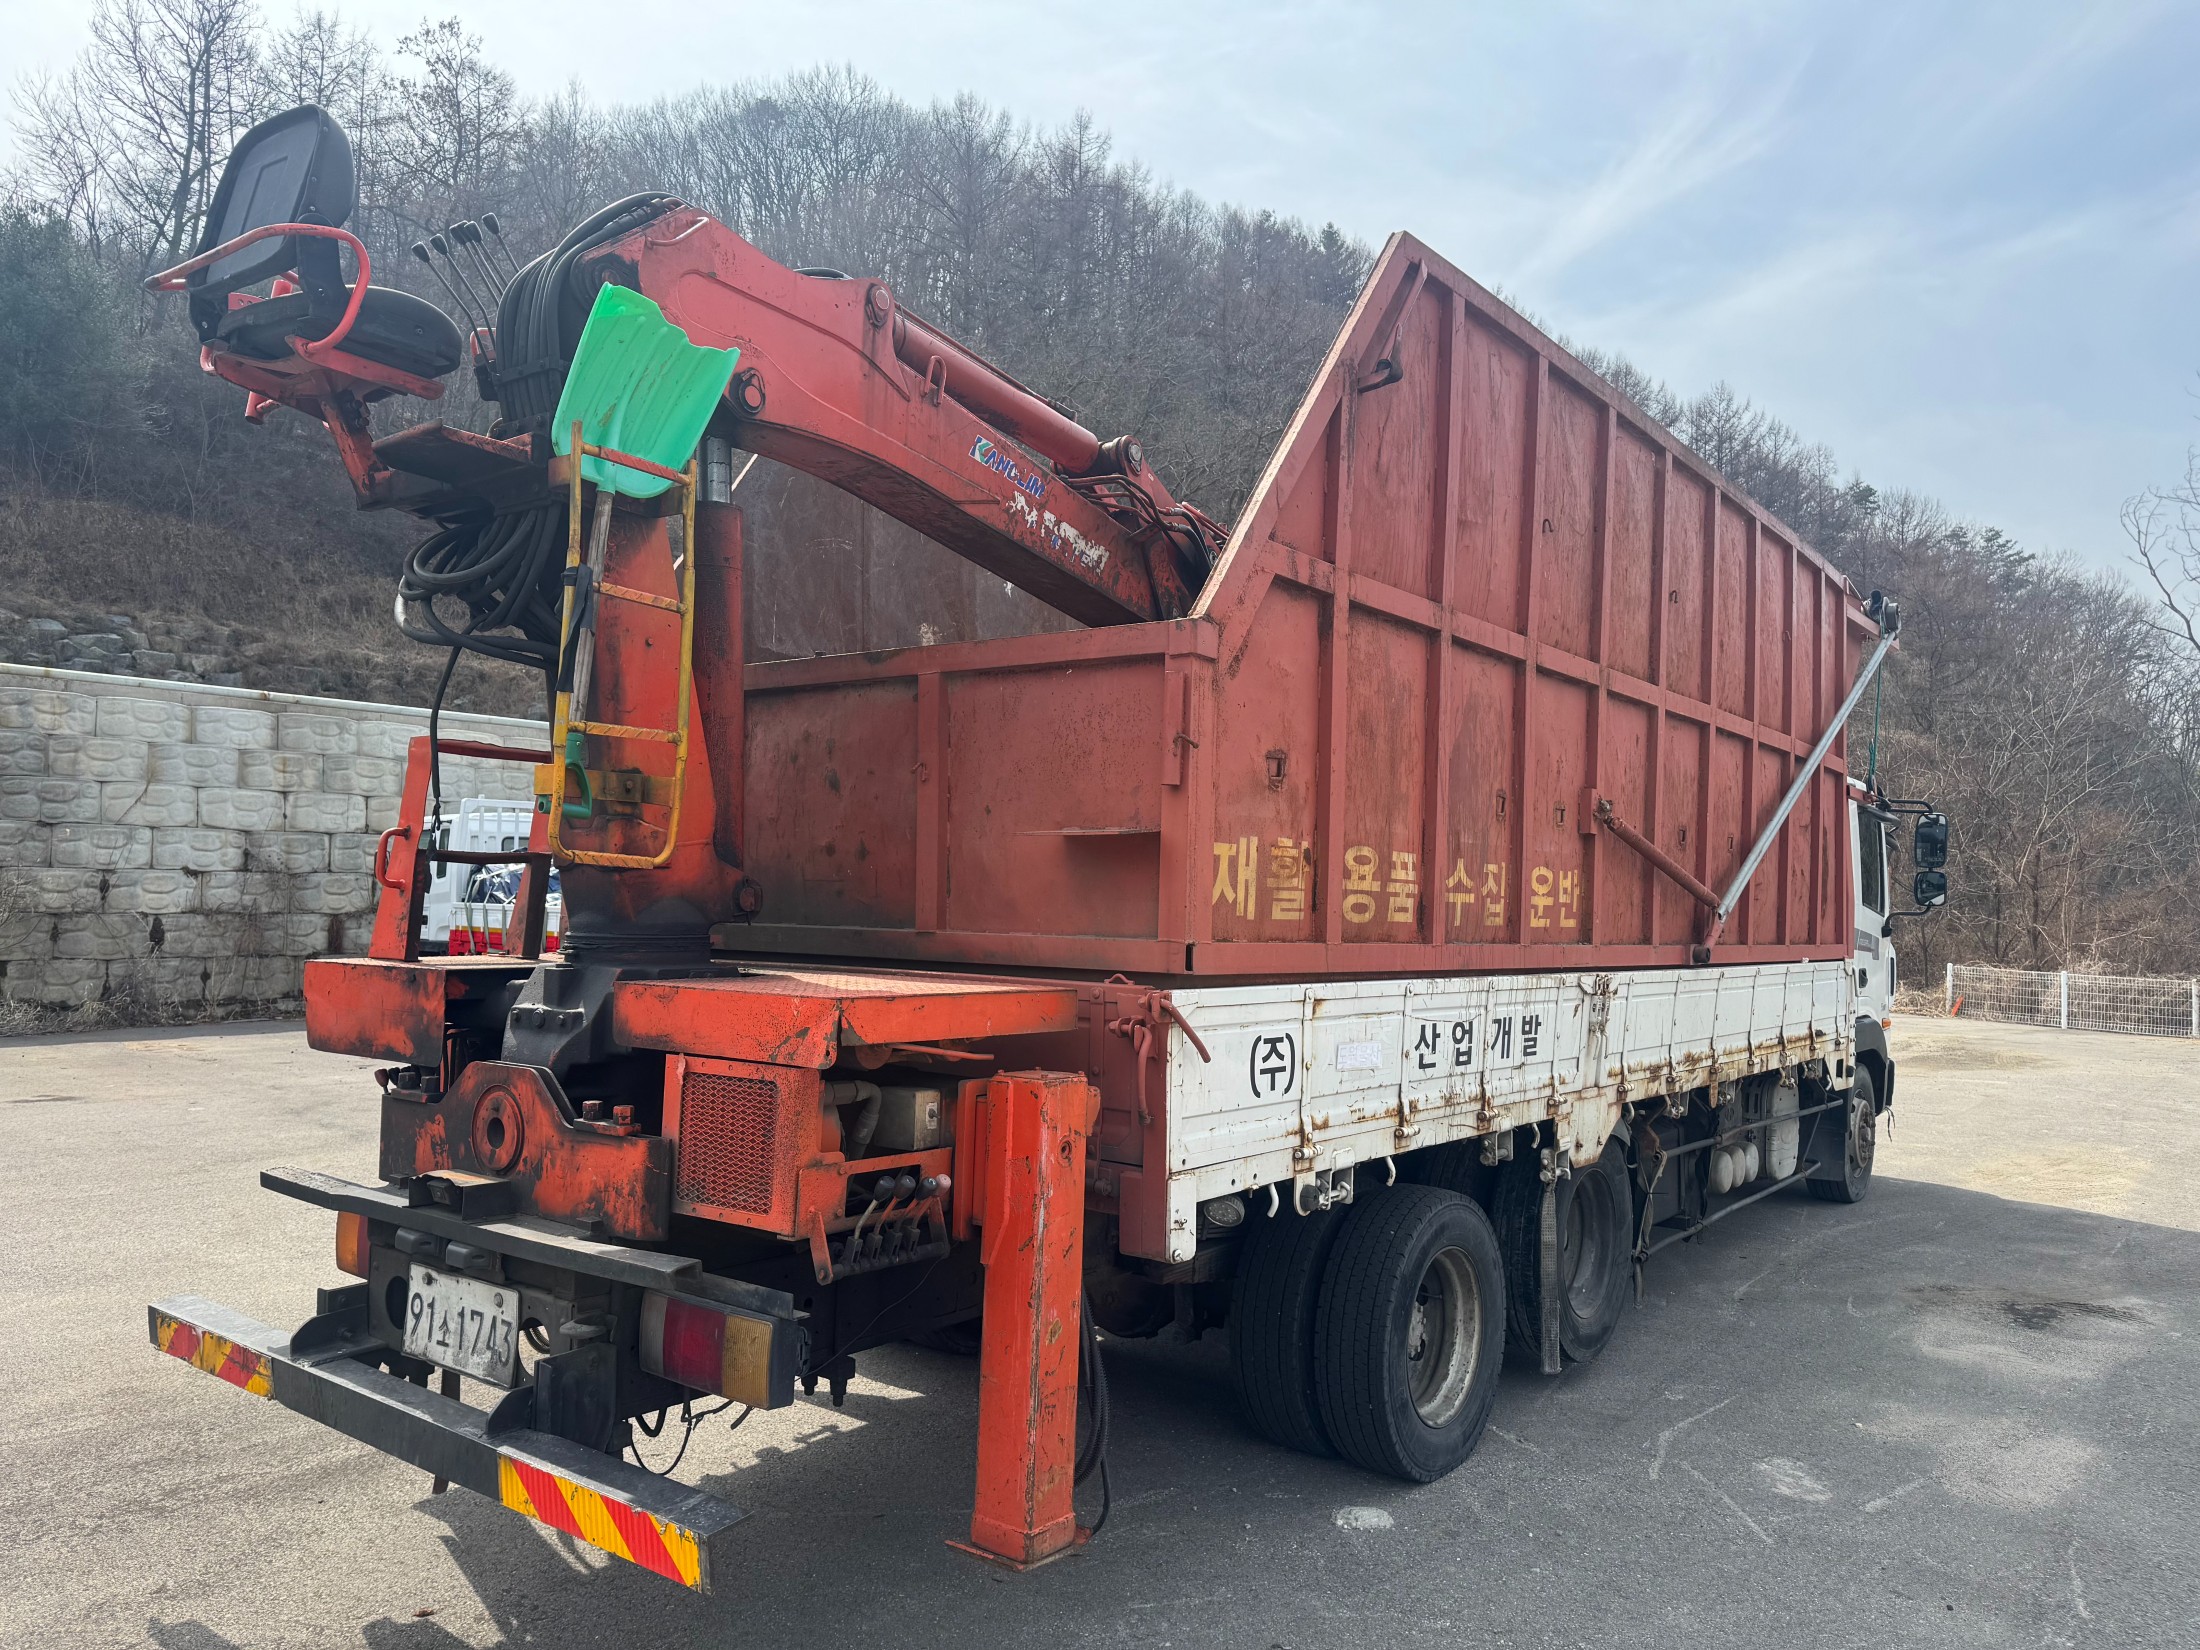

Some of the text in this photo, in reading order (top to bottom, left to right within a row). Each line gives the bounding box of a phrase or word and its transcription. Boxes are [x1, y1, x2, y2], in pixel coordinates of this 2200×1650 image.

[1444, 857, 1506, 927] 수집
[1529, 865, 1581, 928] 운반
[1249, 1032, 1296, 1098] (주)
[410, 1292, 512, 1368] 91소1743
